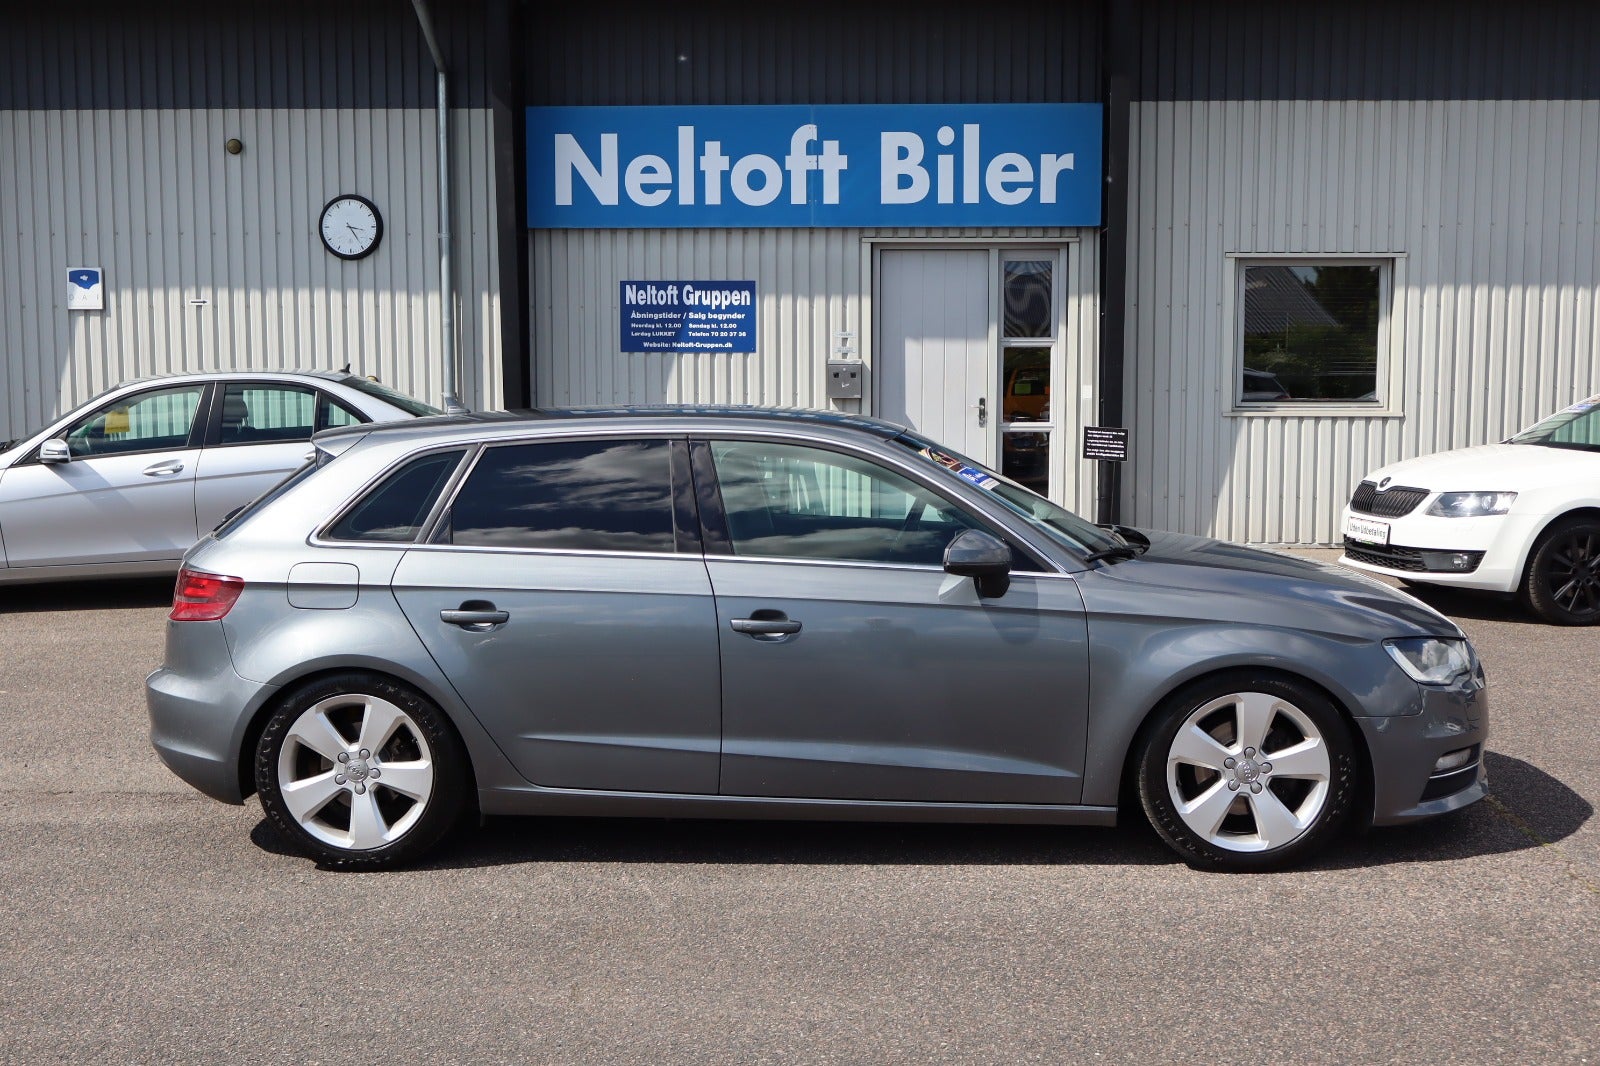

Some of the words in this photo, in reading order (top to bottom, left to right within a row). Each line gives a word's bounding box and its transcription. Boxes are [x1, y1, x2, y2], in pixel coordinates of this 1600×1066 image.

[554, 124, 848, 206] Neltoft
[880, 123, 1074, 206] Biler
[625, 285, 678, 305] Neltoft
[682, 284, 751, 309] Gruppen
[630, 310, 681, 319] Åbningstider
[688, 311, 706, 320] Salg
[707, 312, 746, 321] begynder
